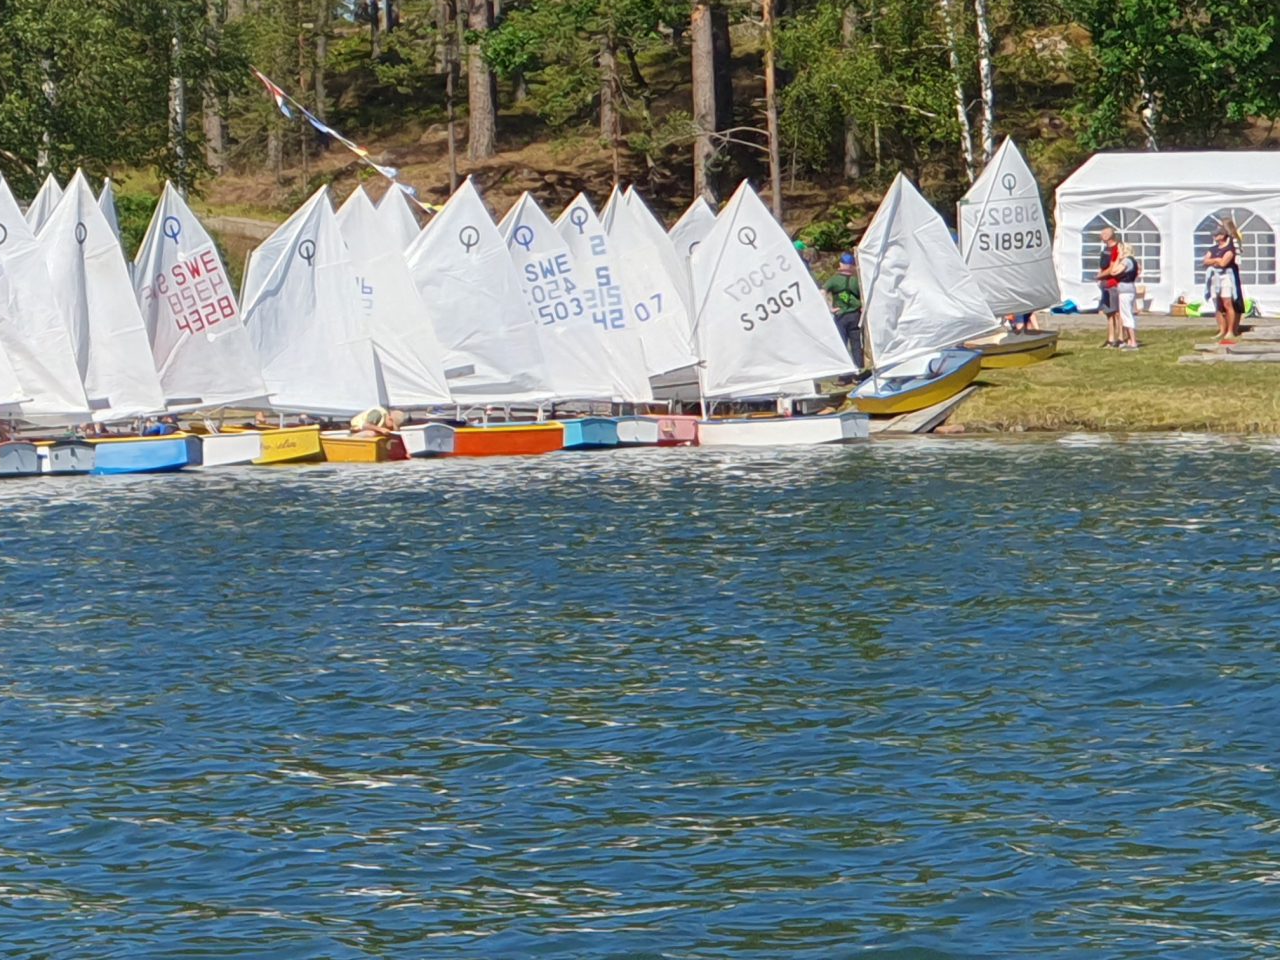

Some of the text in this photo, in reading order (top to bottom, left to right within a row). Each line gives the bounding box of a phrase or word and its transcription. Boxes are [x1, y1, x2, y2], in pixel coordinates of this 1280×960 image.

[172, 250, 218, 286] SWE
[524, 254, 572, 282] SWE
[176, 296, 235, 335] 4328
[535, 297, 584, 325] 503
[740, 281, 801, 331] S 3367
